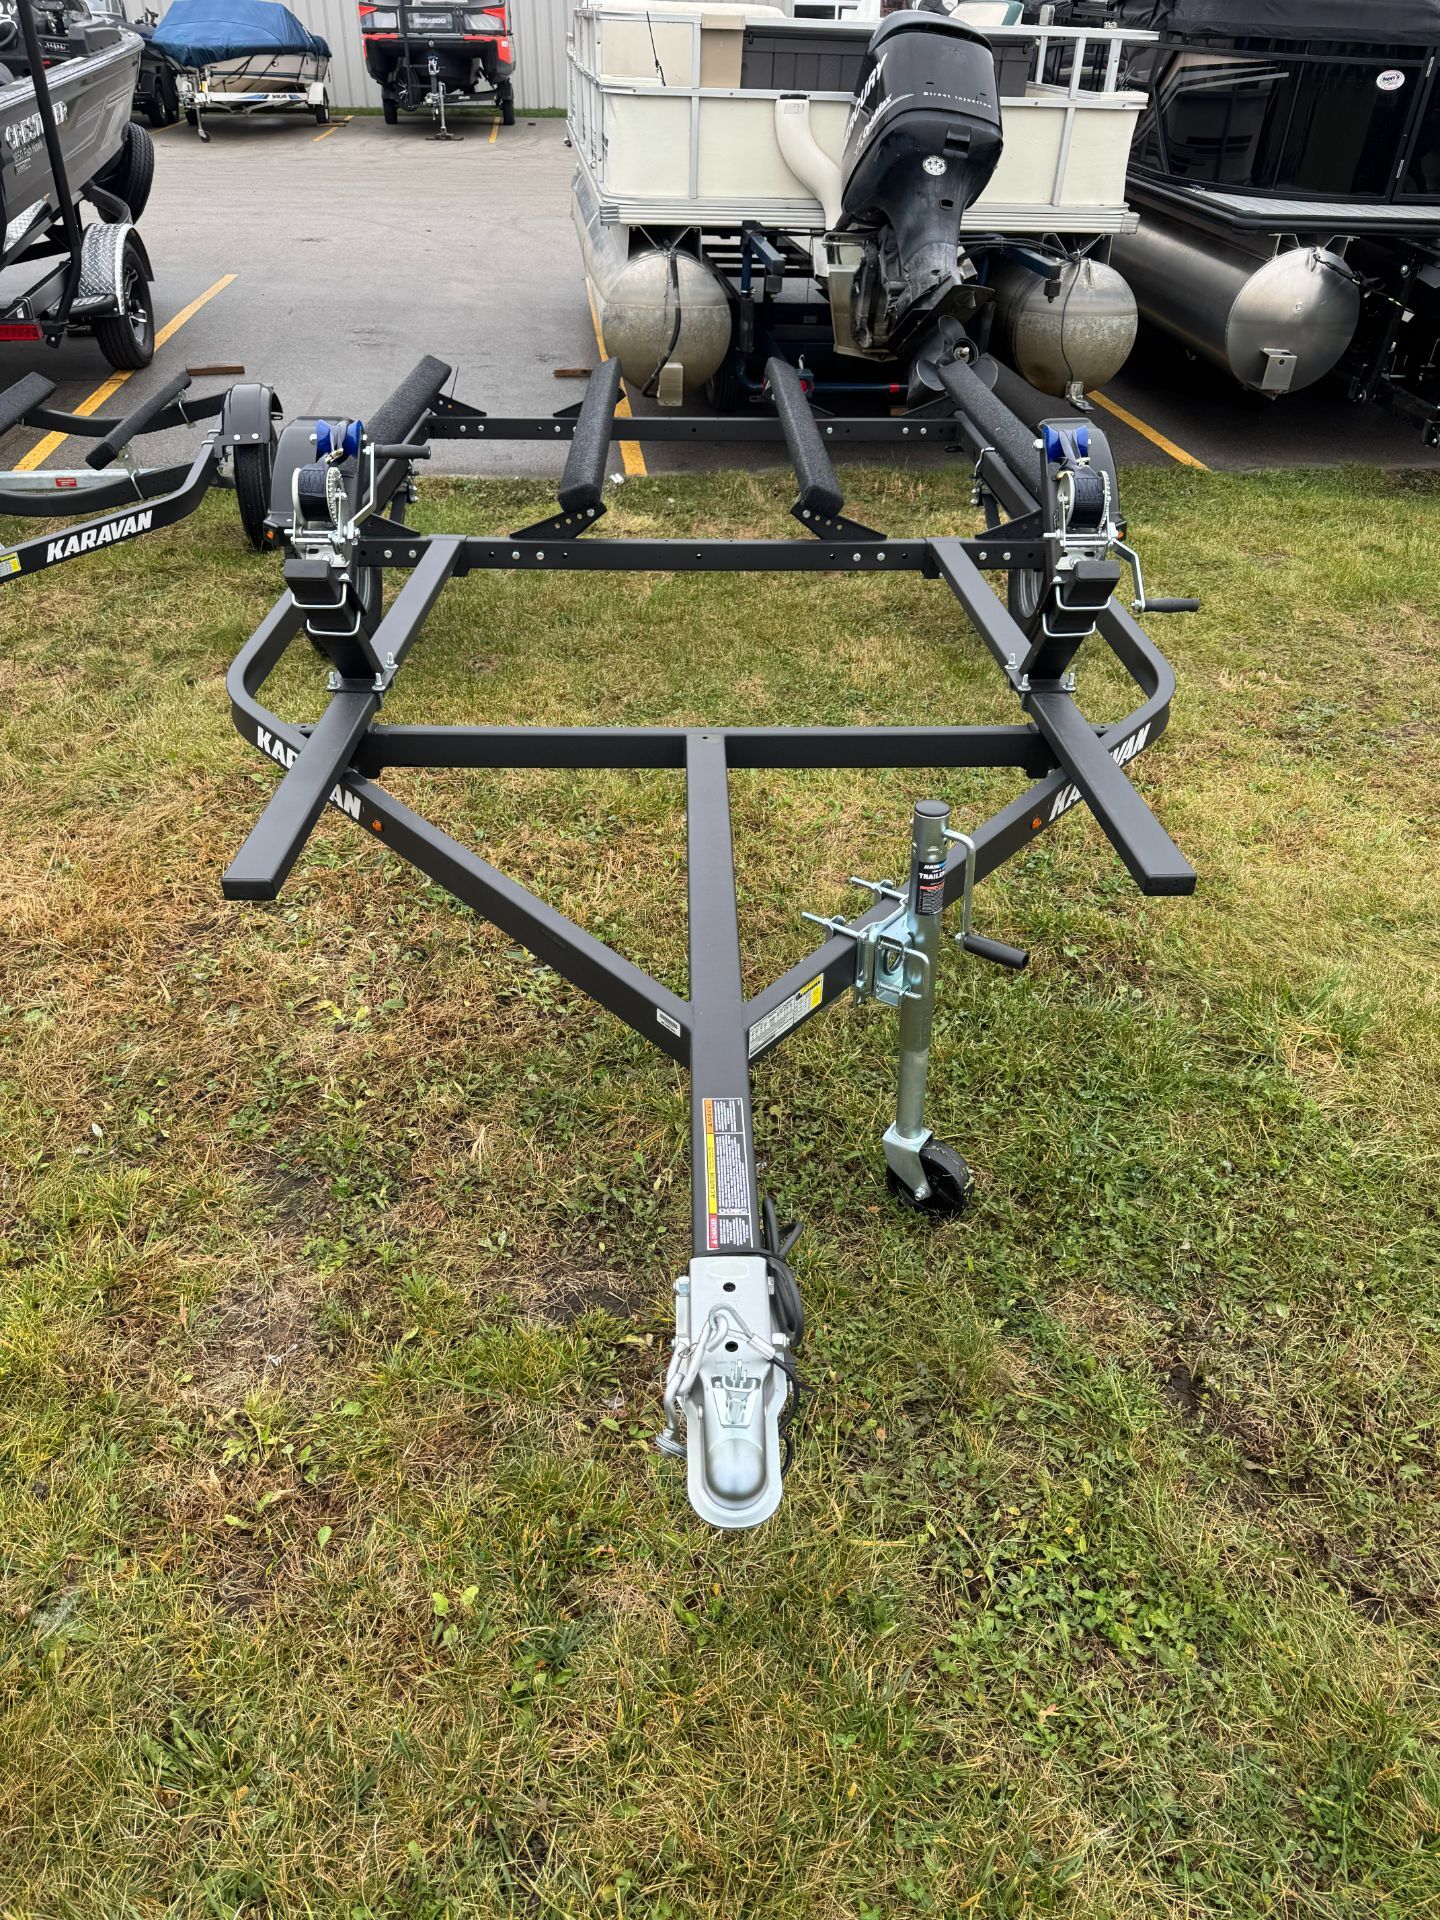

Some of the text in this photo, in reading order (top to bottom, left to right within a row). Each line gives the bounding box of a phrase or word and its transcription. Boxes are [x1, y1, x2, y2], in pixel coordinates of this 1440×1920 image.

[5, 101, 68, 150] CRESTER
[46, 509, 153, 563] KARAVAN
[257, 725, 362, 821] KARAN
[1048, 721, 1152, 822] KAVAN
